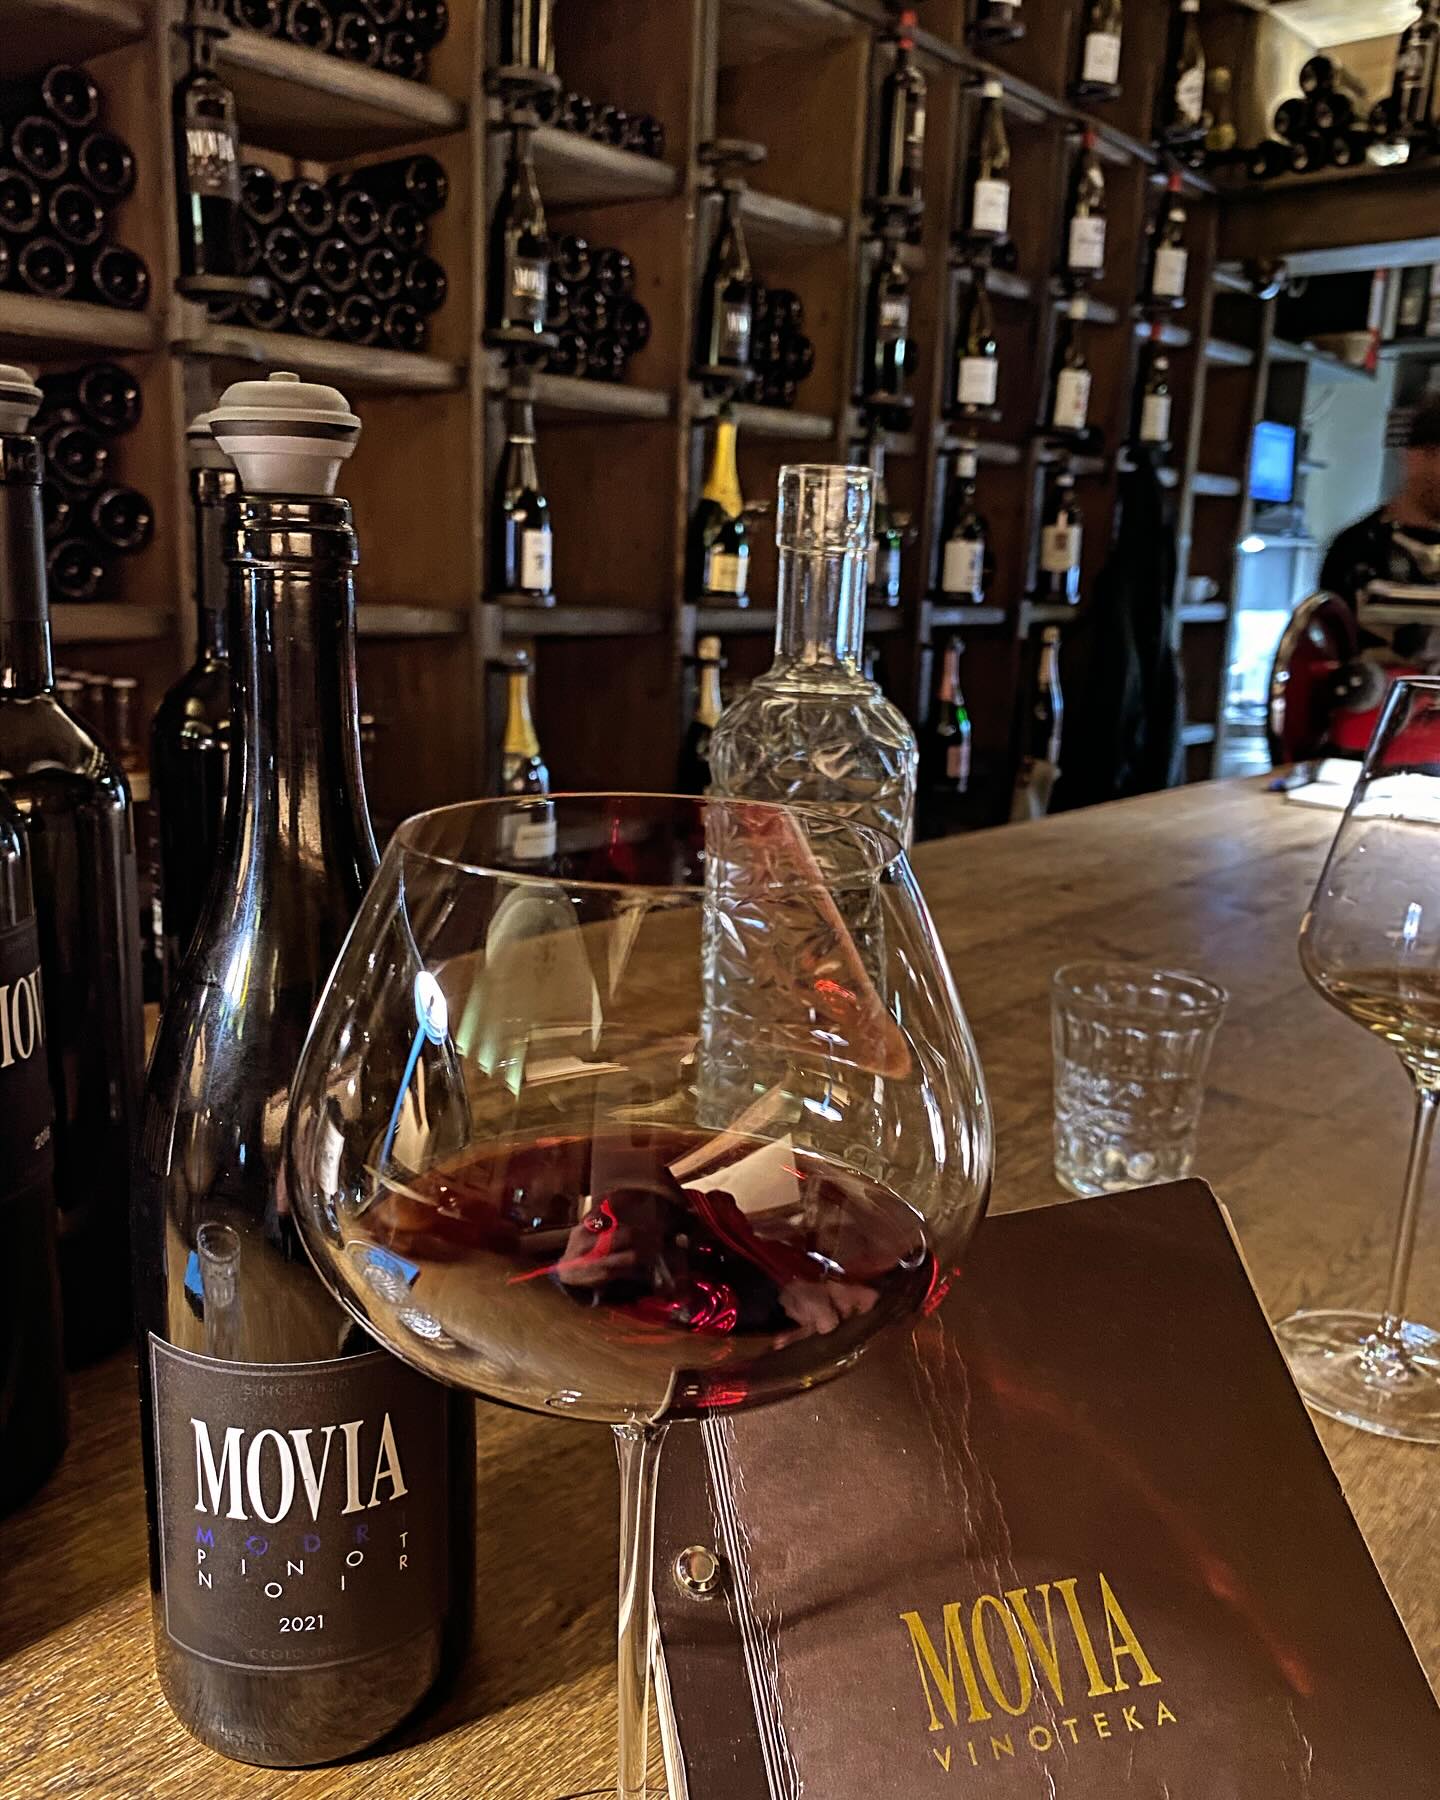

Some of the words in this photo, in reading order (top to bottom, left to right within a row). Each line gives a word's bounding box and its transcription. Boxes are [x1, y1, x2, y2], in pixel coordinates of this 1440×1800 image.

[190, 1412, 409, 1524] MOVIA
[279, 1614, 326, 1633] 2021
[900, 1572, 1162, 1732] MOVIA
[933, 1700, 1178, 1773] VINOTEKA
